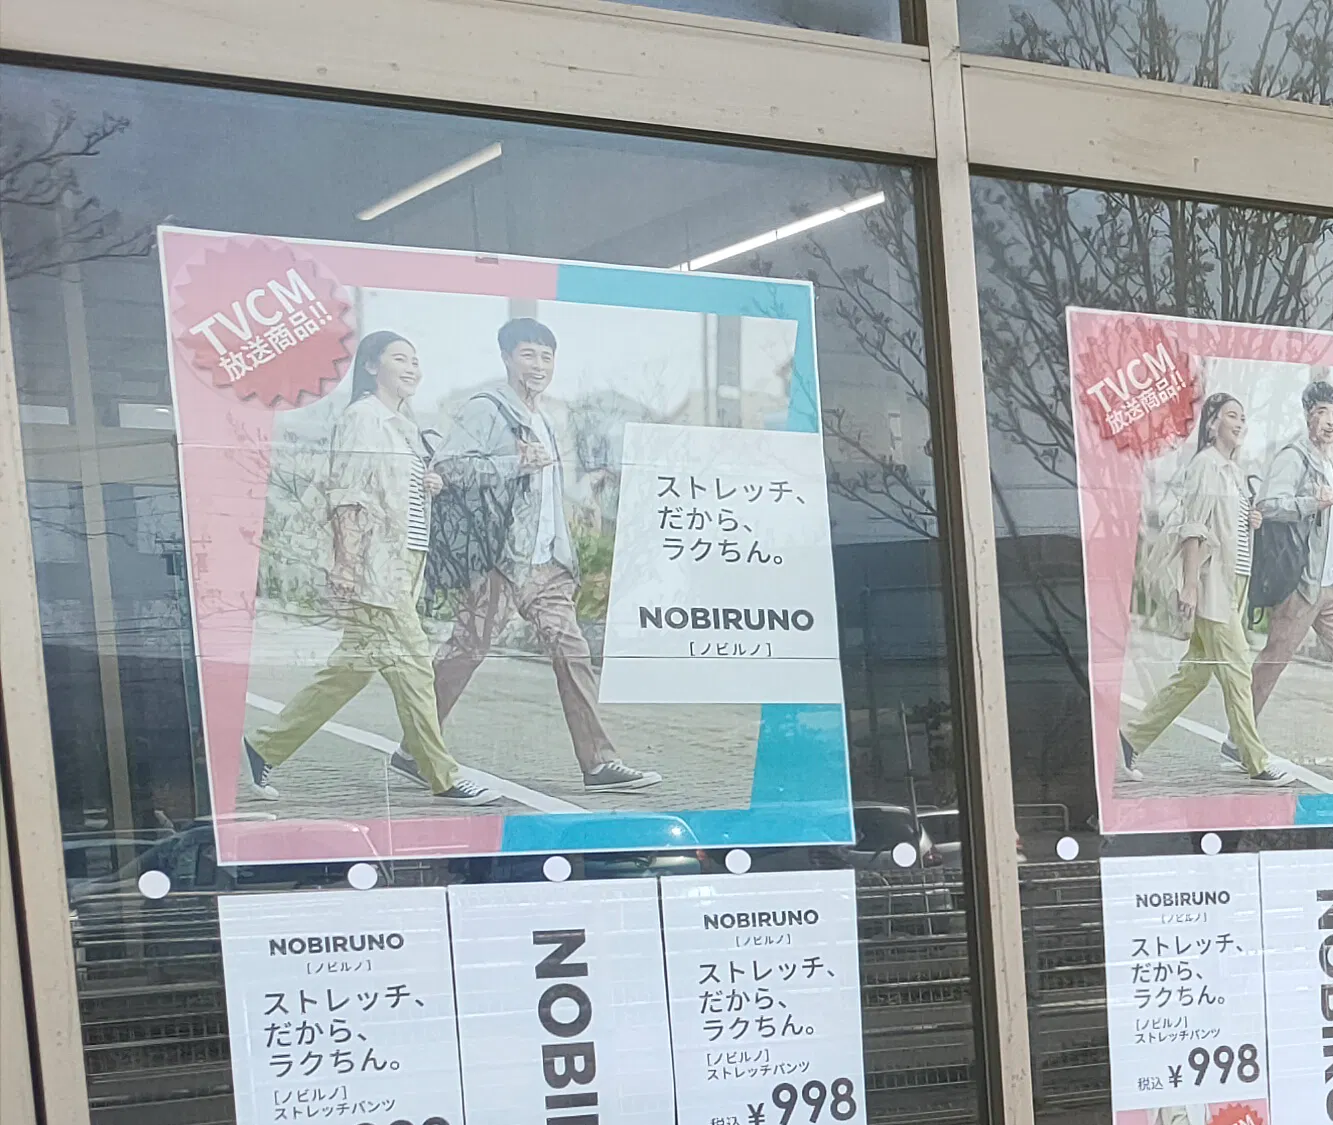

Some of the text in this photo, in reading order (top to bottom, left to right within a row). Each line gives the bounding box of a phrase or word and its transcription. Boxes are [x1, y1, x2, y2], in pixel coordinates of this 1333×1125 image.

[189, 268, 316, 355] TVCM
[1087, 343, 1175, 413] TVCM
[658, 476, 805, 504] ストレッチ、
[658, 507, 752, 532] だから、
[663, 538, 782, 564] ラクちん。
[639, 607, 814, 631] NOBIRUNO
[690, 642, 771, 657] [ノビルノ]
[1136, 890, 1230, 908] NOBIRUNO
[704, 909, 819, 929] NOBIRUNO
[269, 933, 404, 955] NOBIRUNO
[736, 934, 791, 947] [ノビルノ]
[1131, 933, 1243, 957] ストレッチ、
[307, 960, 371, 974] [ノビルノ]
[699, 956, 835, 984] ストレッチ、
[1131, 960, 1203, 984] だから、
[264, 984, 424, 1015] ストレッチ、
[699, 988, 787, 1014] だから、
[1134, 985, 1225, 1009] ラクちん。
[264, 1020, 367, 1048] だから、
[703, 1014, 814, 1041] ラクちん。
[1136, 1016, 1188, 1031] [ノビルノ]
[1136, 1028, 1220, 1044] ストレッチパンツ
[270, 1049, 400, 1077] ラクちん。
[707, 1049, 769, 1066] [ノビルノ]
[707, 1061, 810, 1080] ストレッチパンツ
[275, 1086, 347, 1105] [ノビルノ]
[1137, 1077, 1164, 1091] 税込
[275, 1099, 395, 1120] ストレッチパンツ
